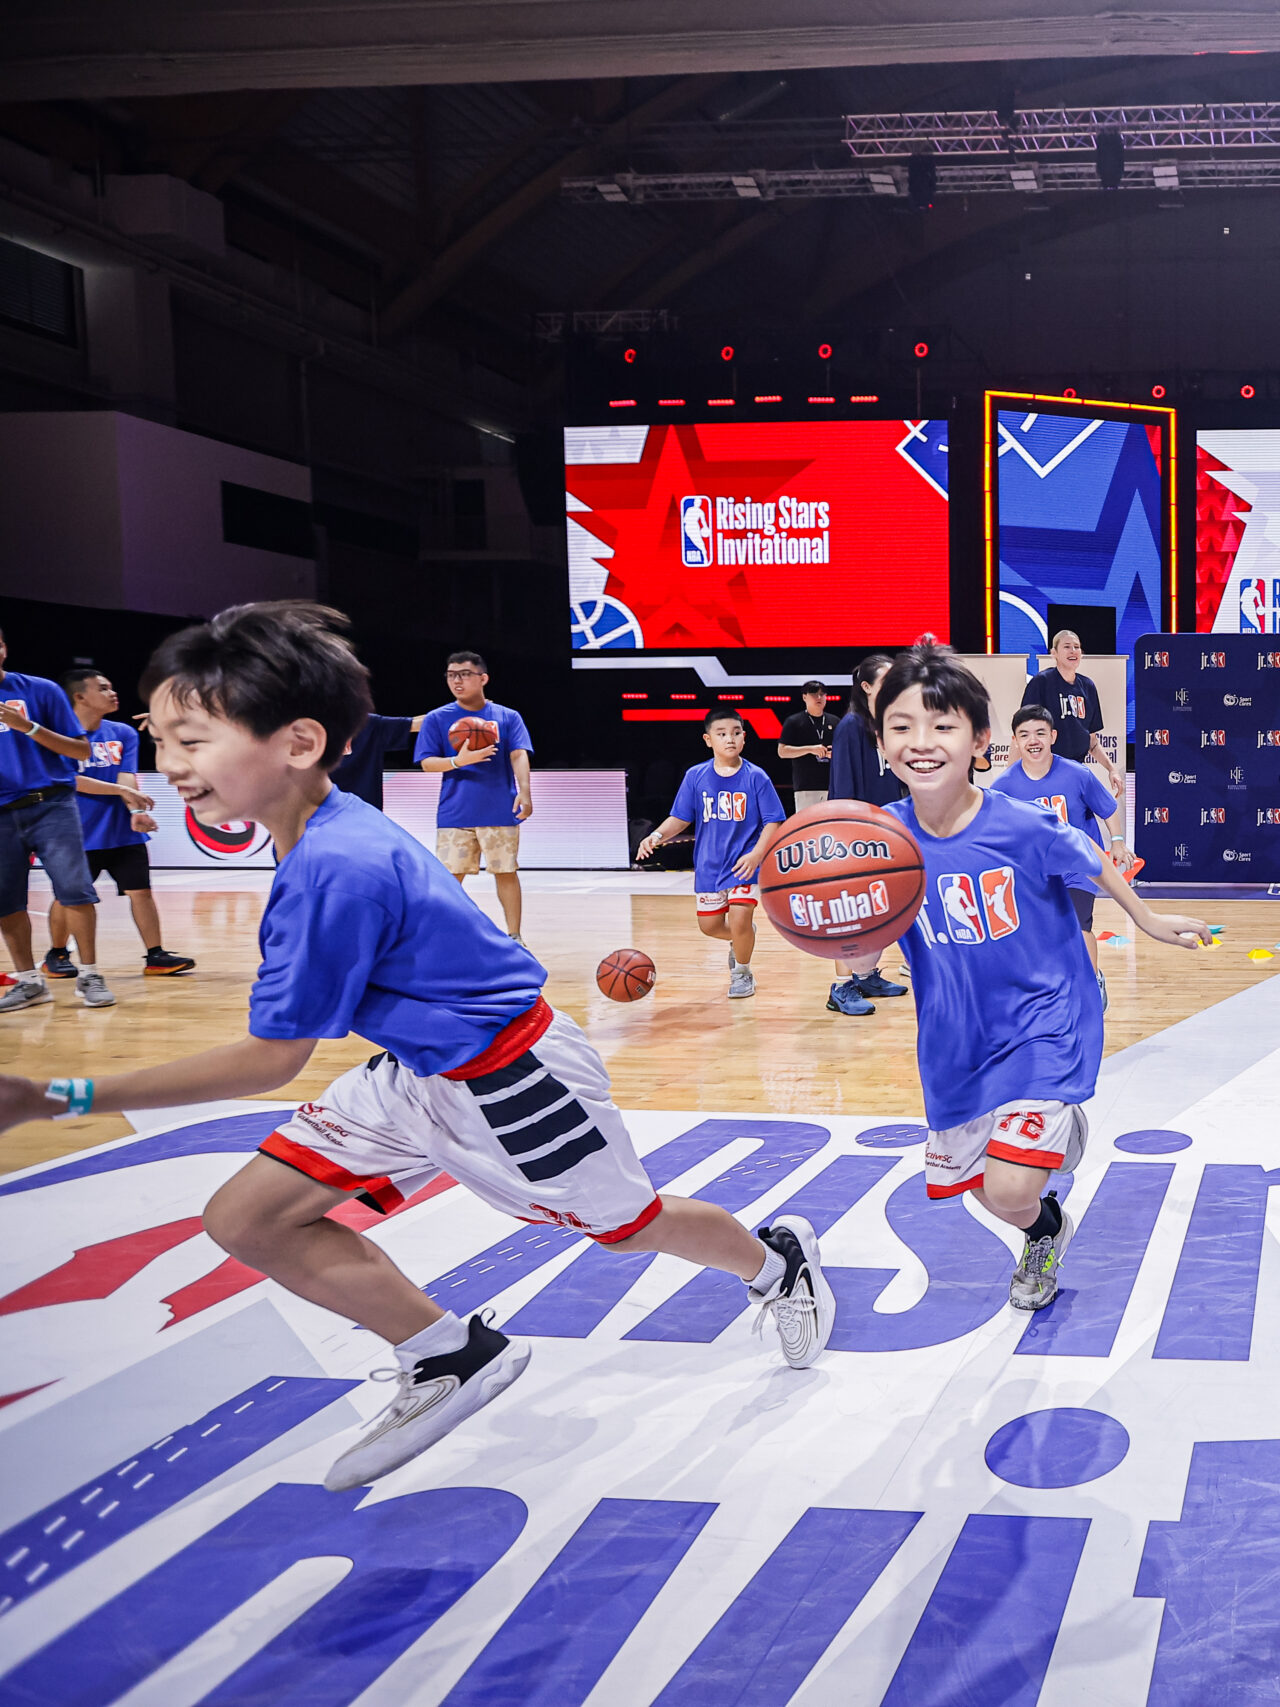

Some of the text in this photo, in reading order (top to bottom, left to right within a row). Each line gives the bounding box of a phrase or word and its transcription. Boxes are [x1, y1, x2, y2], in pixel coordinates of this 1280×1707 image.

[716, 496, 830, 535] Rising Stars
[716, 531, 830, 566] Invitational
[990, 743, 1010, 754] Spor
[702, 791, 717, 823] jr.
[775, 835, 892, 874] Wilson
[806, 888, 874, 931] jr.nba
[955, 929, 973, 939] NBA
